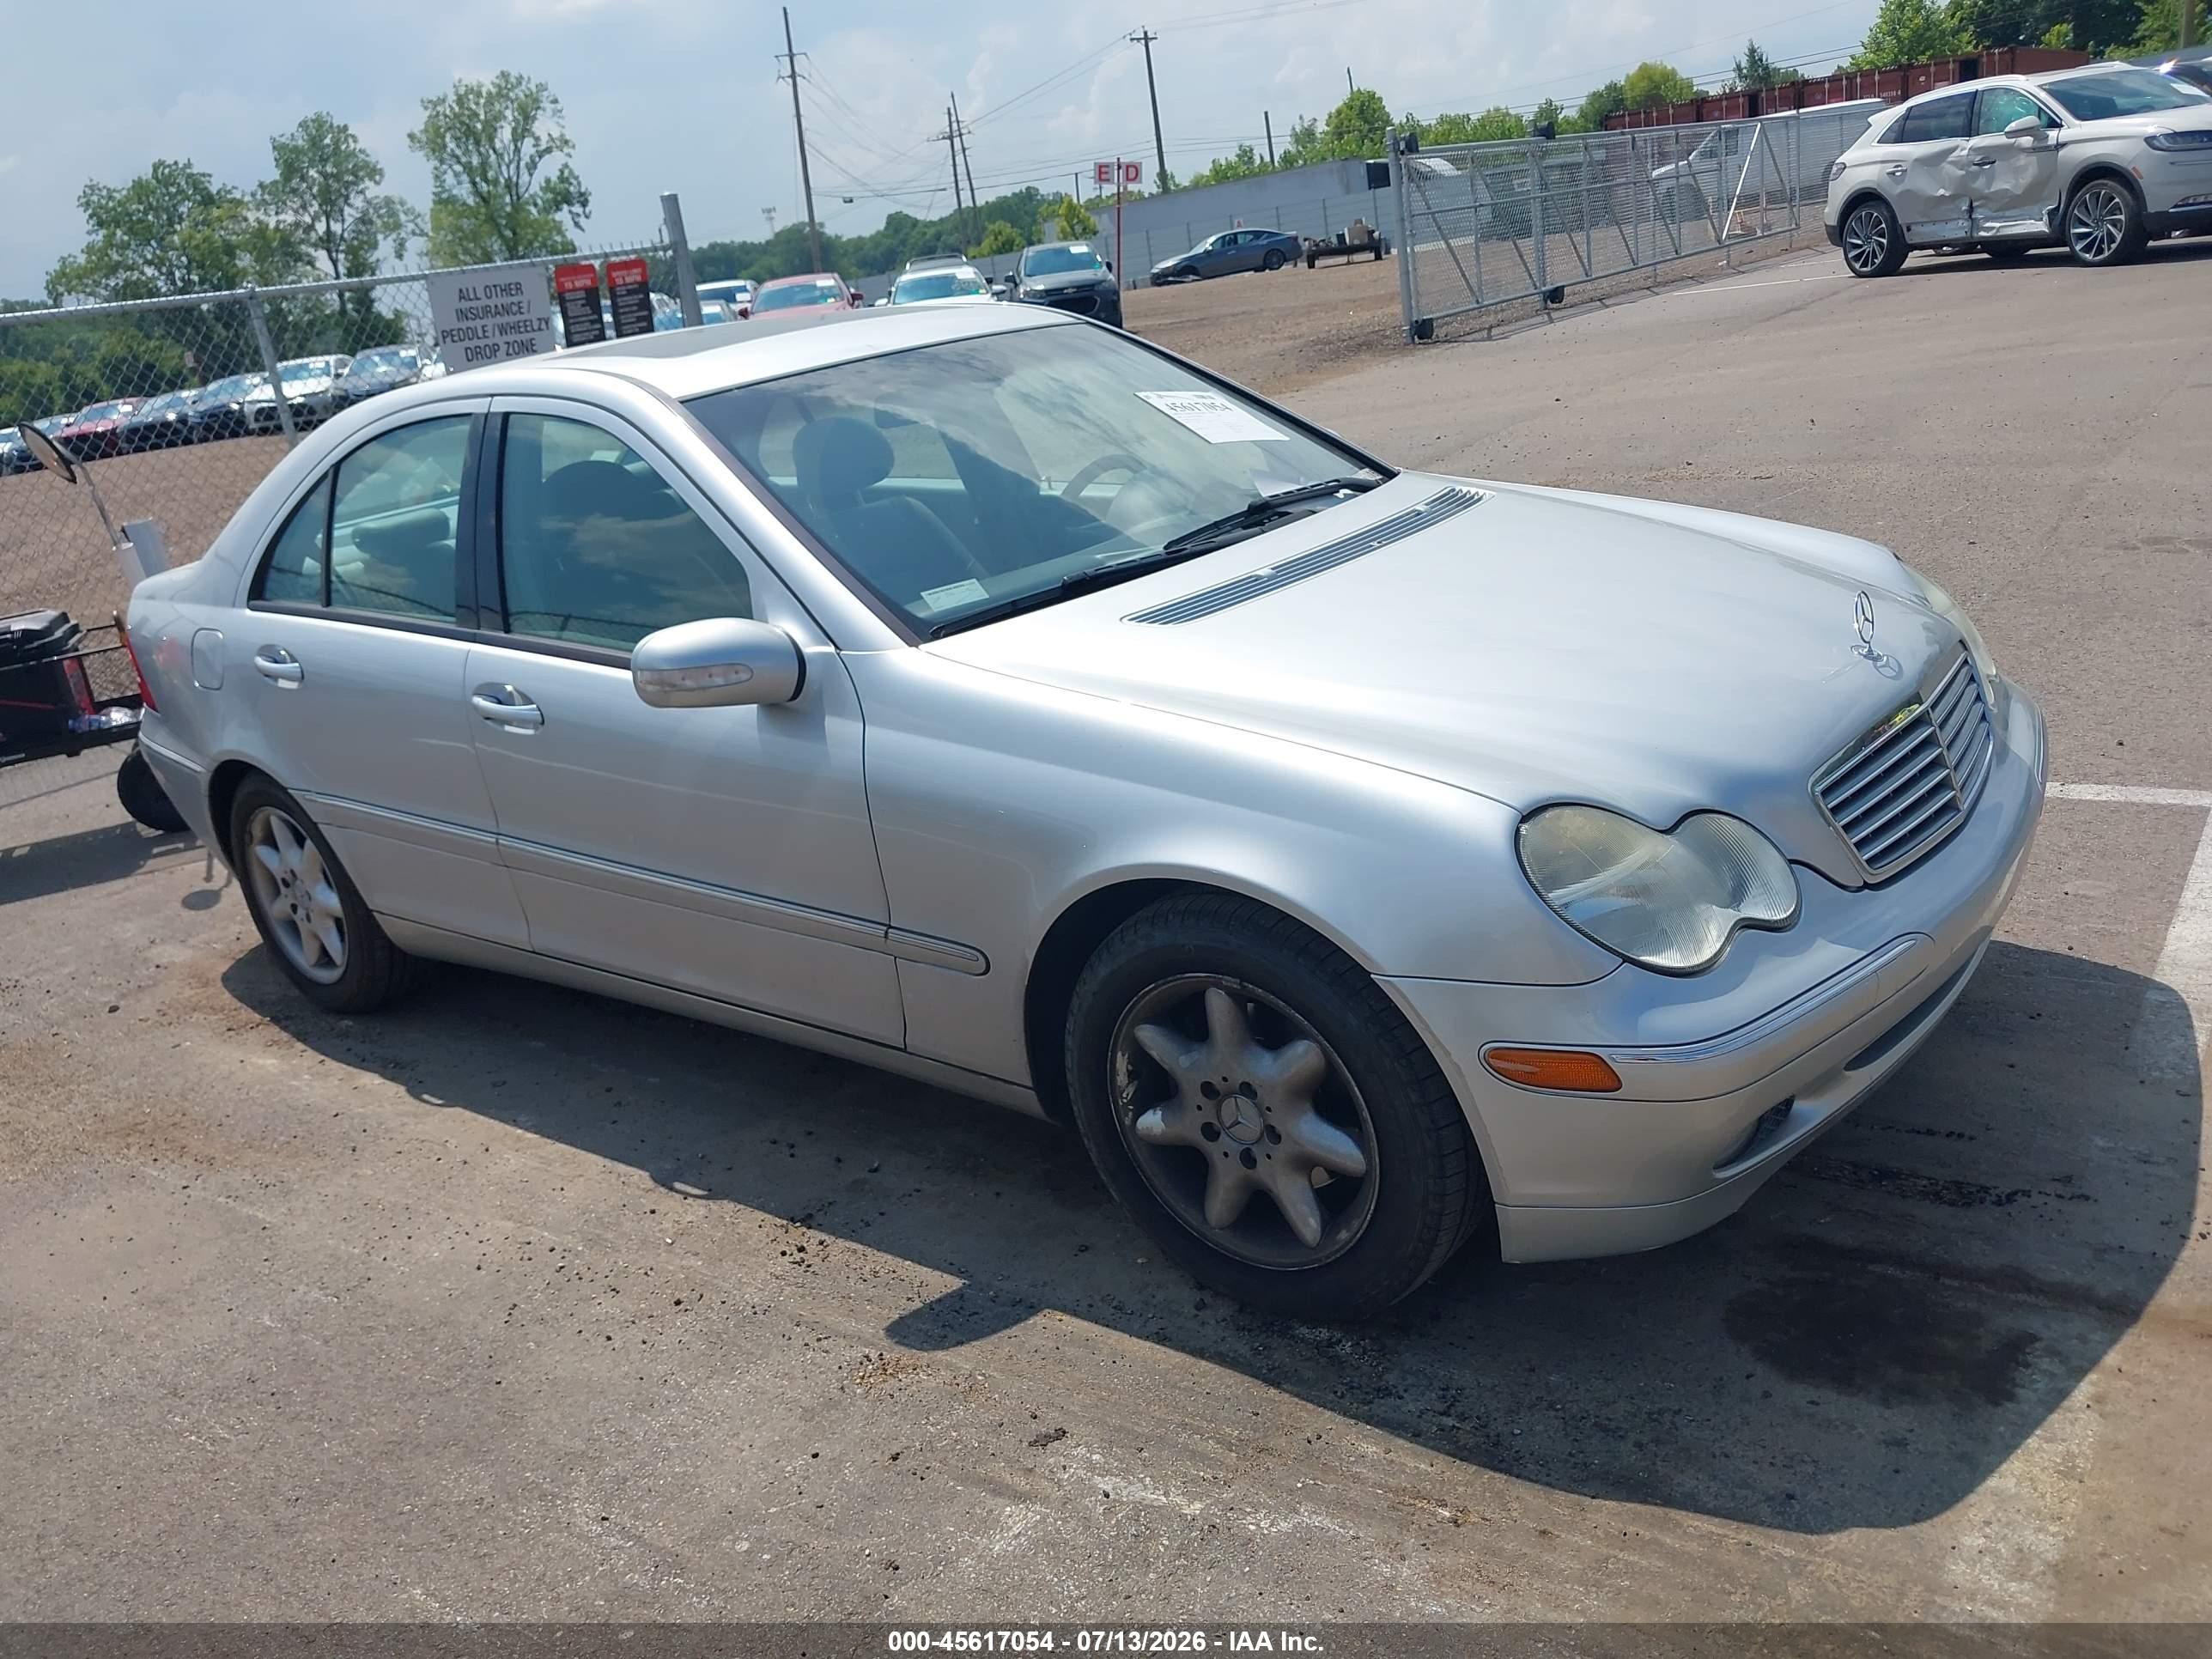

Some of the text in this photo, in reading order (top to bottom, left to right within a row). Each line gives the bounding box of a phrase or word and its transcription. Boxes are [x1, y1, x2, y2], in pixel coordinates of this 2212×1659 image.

[1098, 164, 1110, 182] E
[1126, 164, 1139, 182] D
[459, 282, 524, 303] ALL OTHER
[455, 301, 526, 323] INSURANCE
[441, 324, 490, 344] PEDDLE
[465, 337, 538, 362] DROP ZONE
